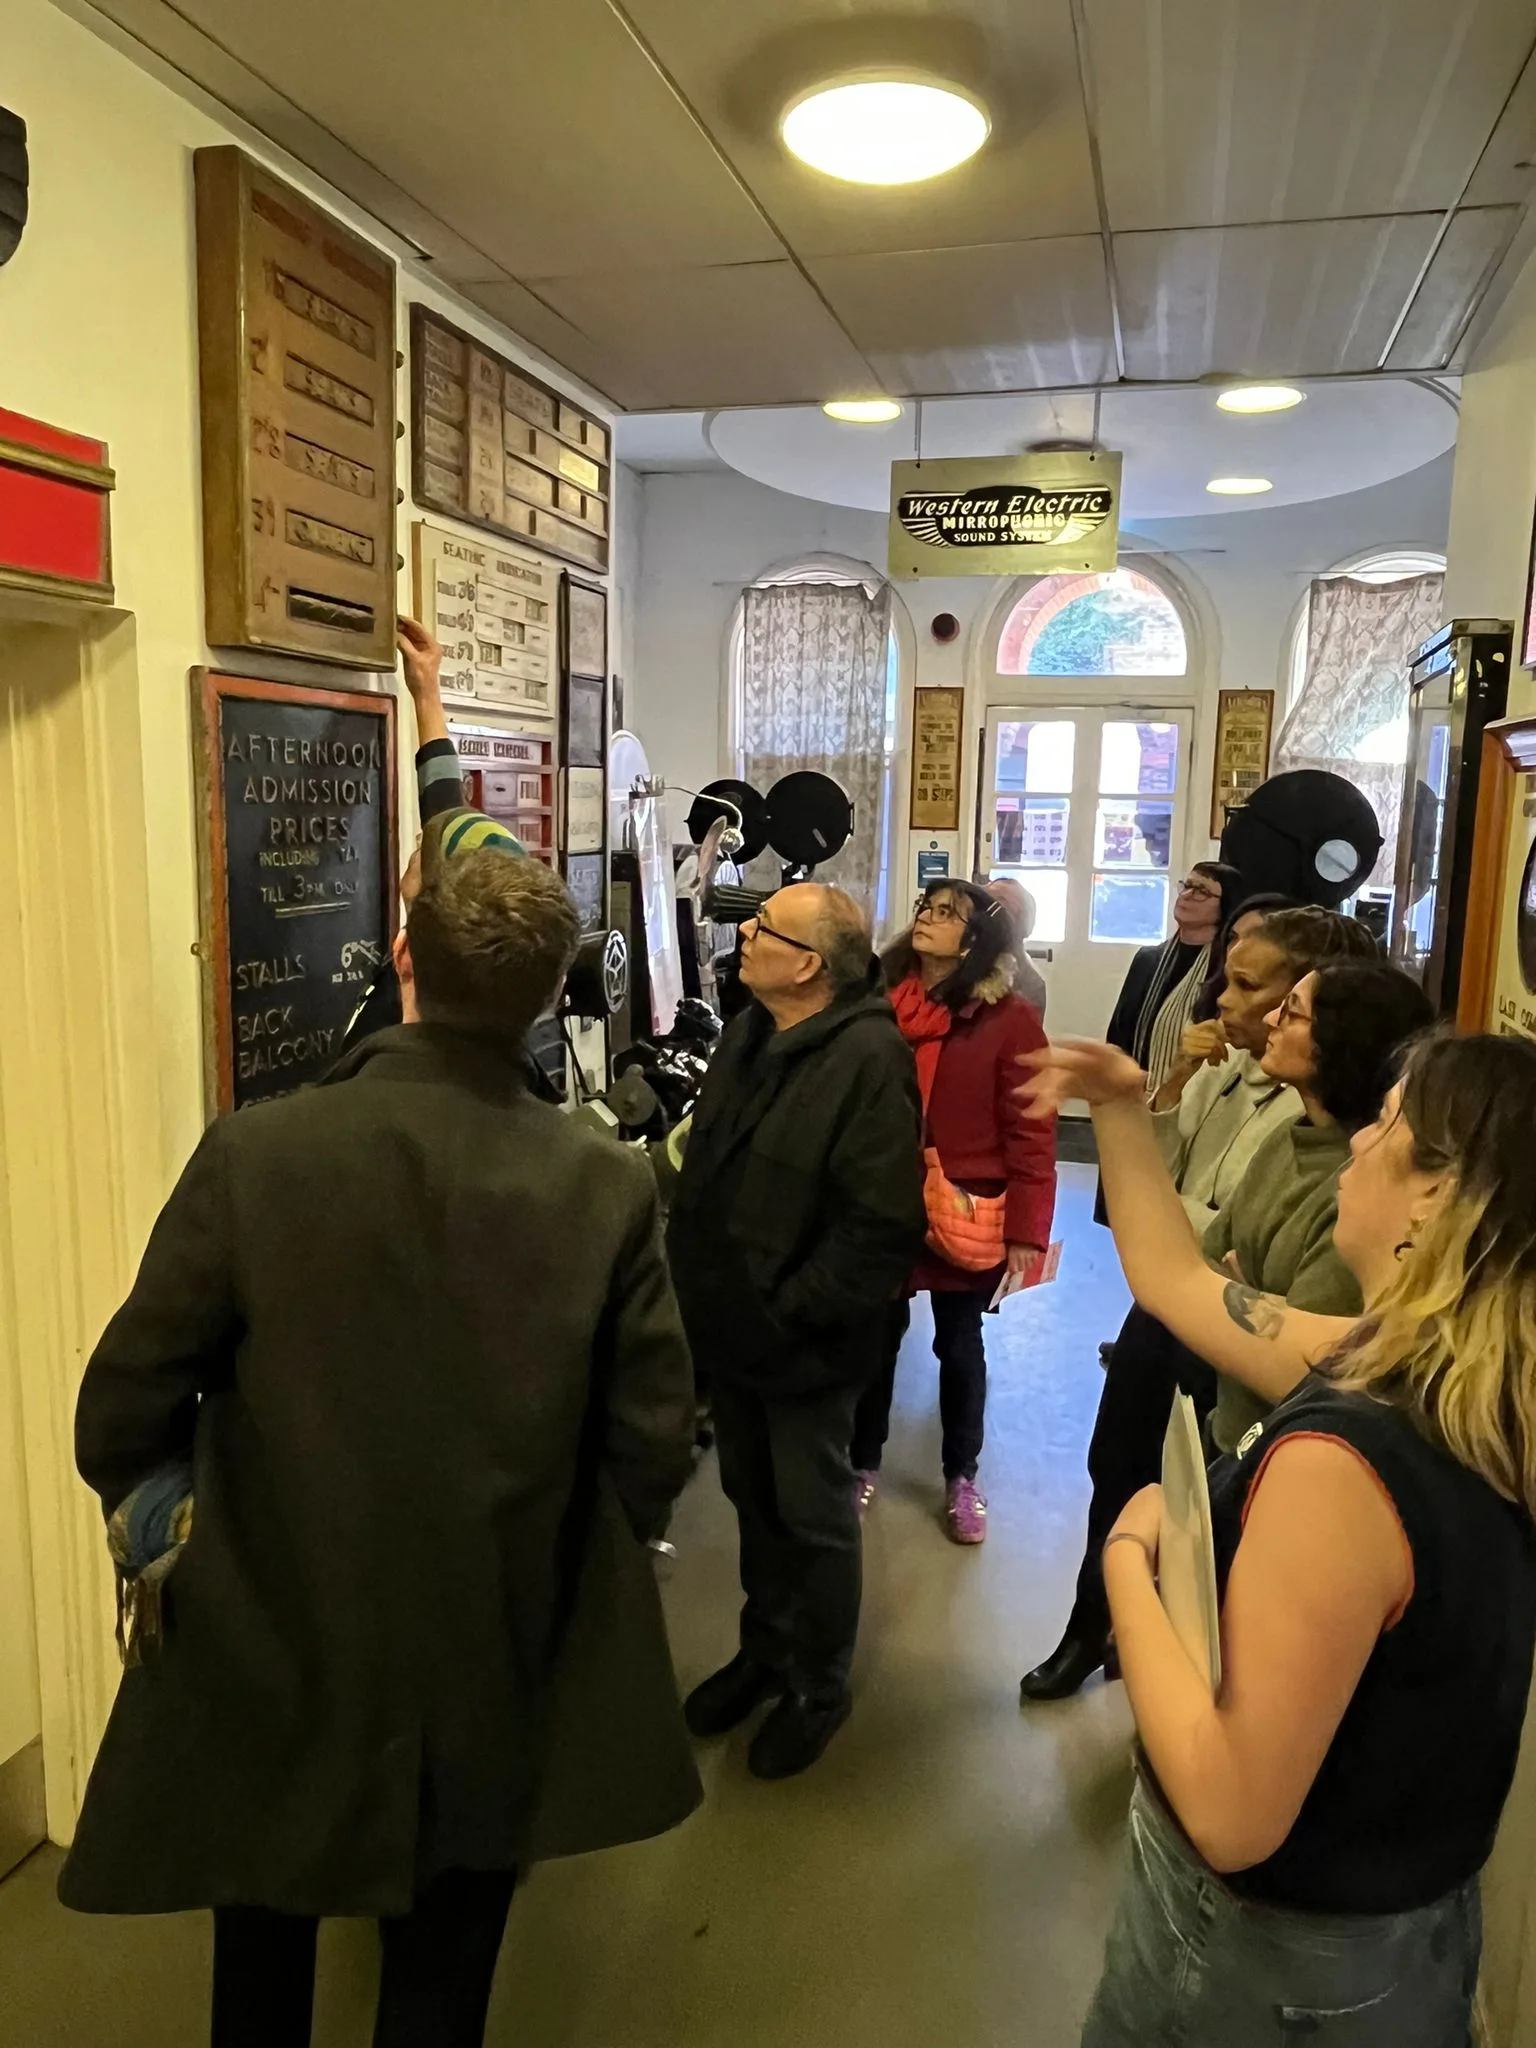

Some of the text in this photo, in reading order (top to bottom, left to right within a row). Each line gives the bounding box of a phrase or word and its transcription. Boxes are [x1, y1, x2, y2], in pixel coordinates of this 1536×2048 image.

[909, 494, 1103, 517] Western Electric
[942, 513, 1066, 530] MIRROPHONIC
[953, 532, 996, 543] SOUND
[227, 732, 381, 769] AFTERNOON
[243, 775, 371, 805] ADMISSION
[270, 816, 350, 845] PRICES
[260, 886, 286, 903] TILL
[236, 953, 307, 990] STALLS
[237, 1005, 294, 1043] BACK
[238, 1028, 335, 1079] BALCONY
